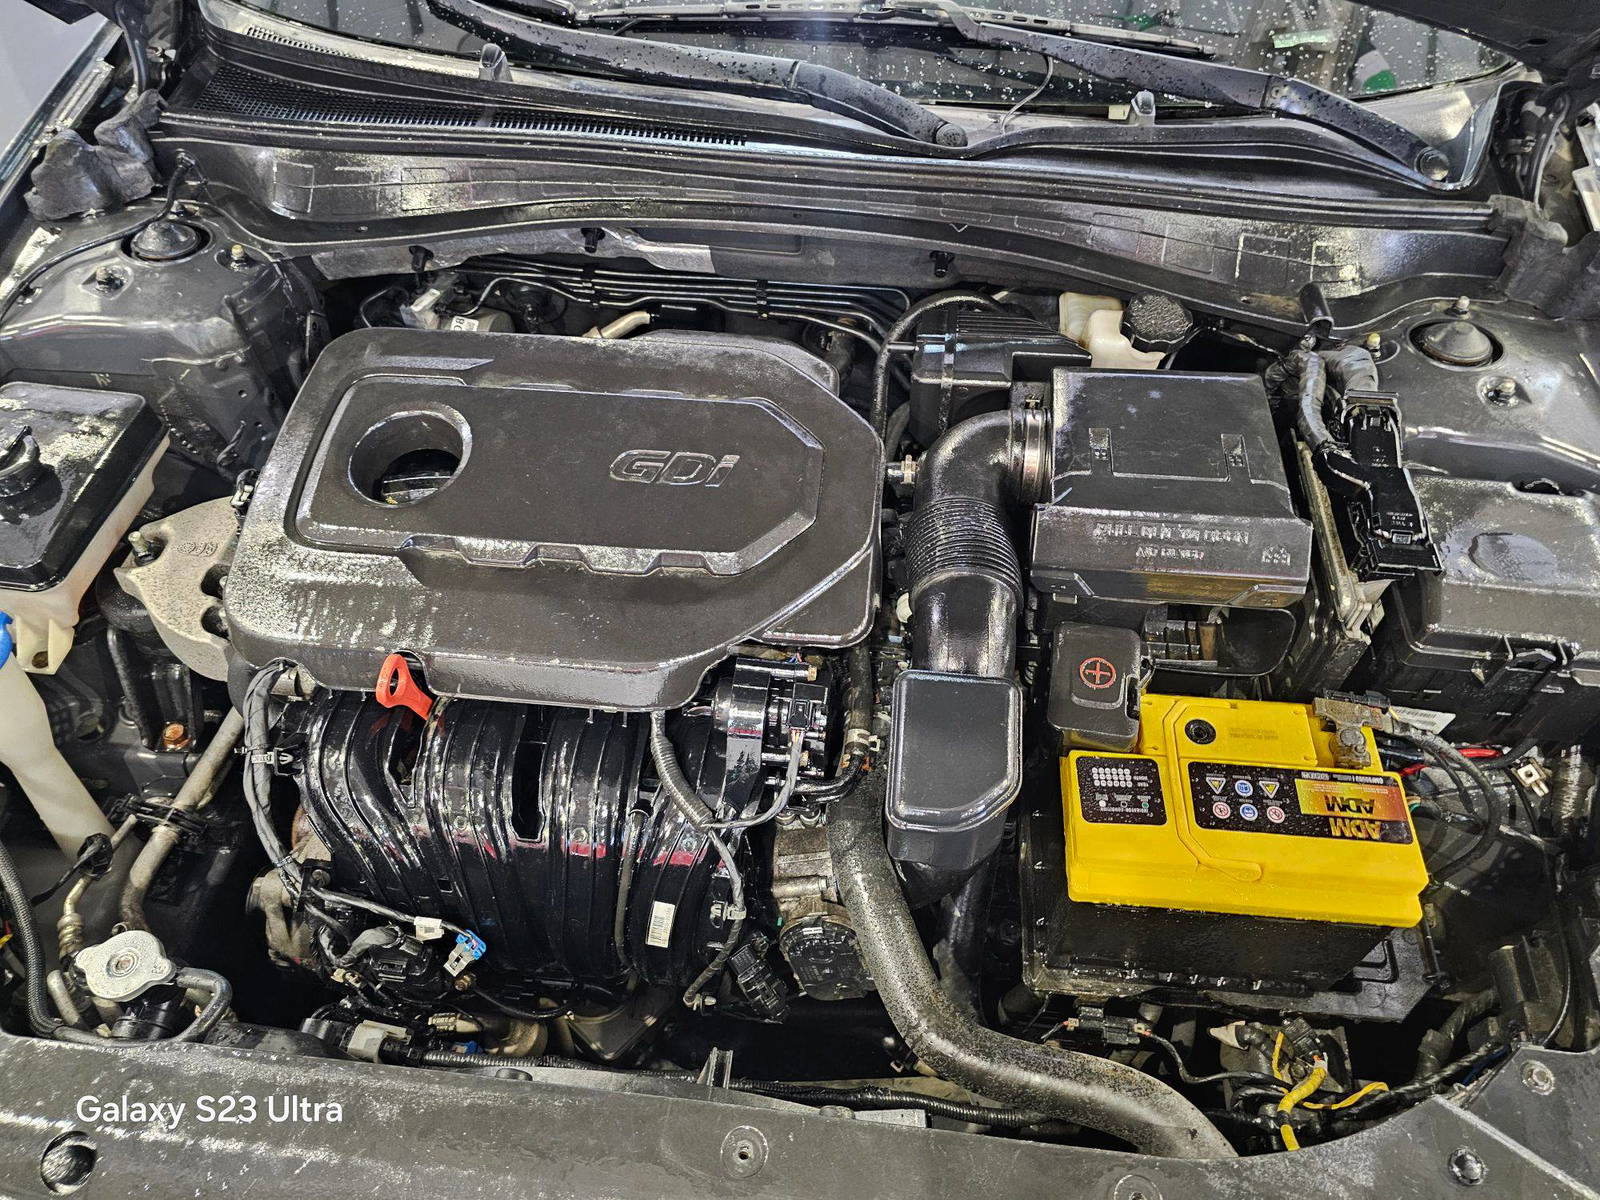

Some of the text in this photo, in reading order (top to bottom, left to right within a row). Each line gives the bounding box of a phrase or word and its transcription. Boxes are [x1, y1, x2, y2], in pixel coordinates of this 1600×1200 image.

[609, 449, 740, 487] GDi
[1324, 794, 1375, 815] ADM
[1328, 818, 1382, 840] ADM
